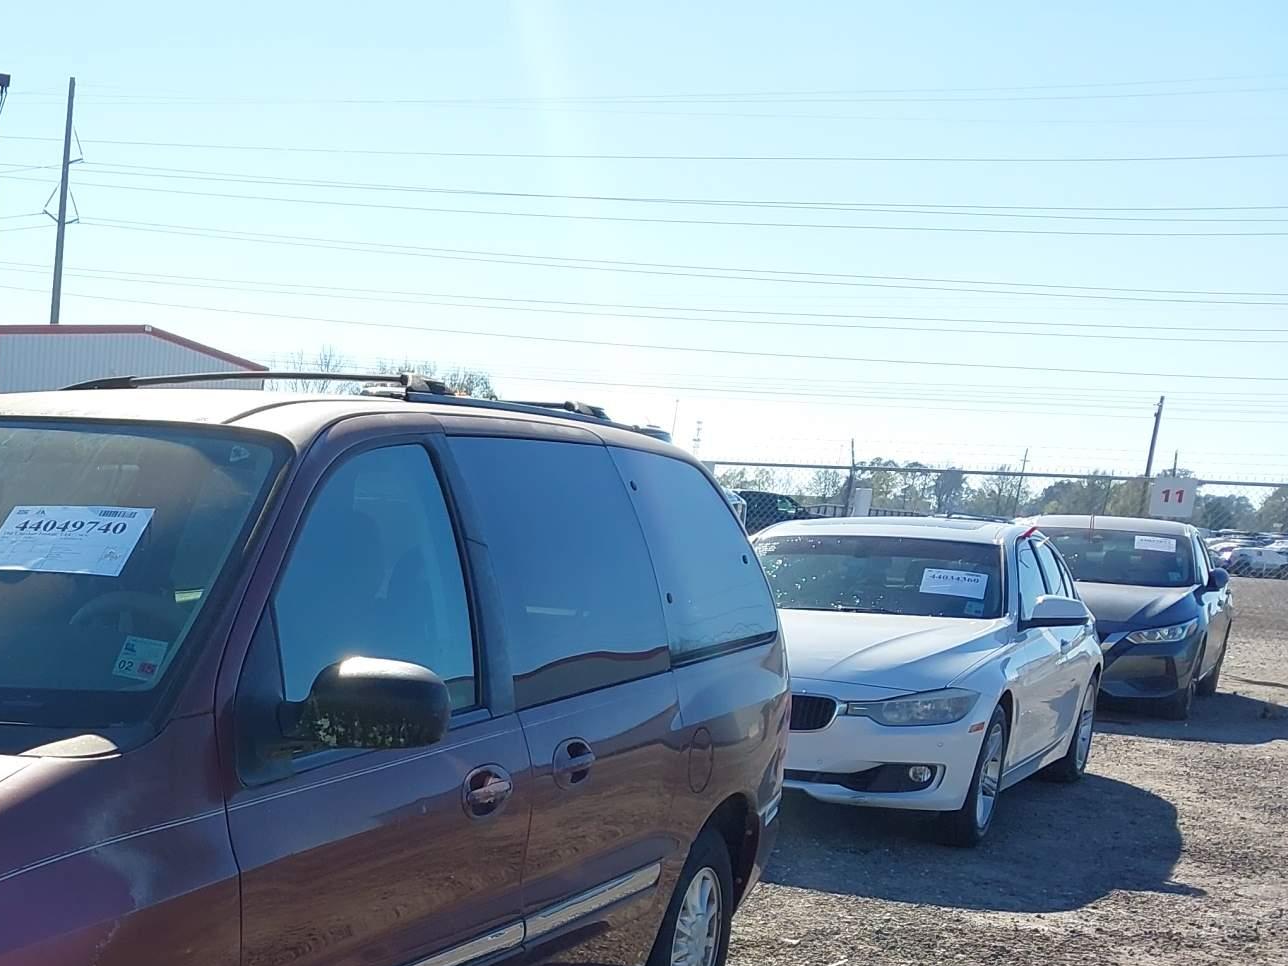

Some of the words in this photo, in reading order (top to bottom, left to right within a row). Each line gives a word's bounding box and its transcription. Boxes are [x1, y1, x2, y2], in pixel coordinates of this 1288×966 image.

[1162, 489, 1185, 503] 11
[15, 519, 128, 535] 44049740
[118, 659, 134, 671] 02
